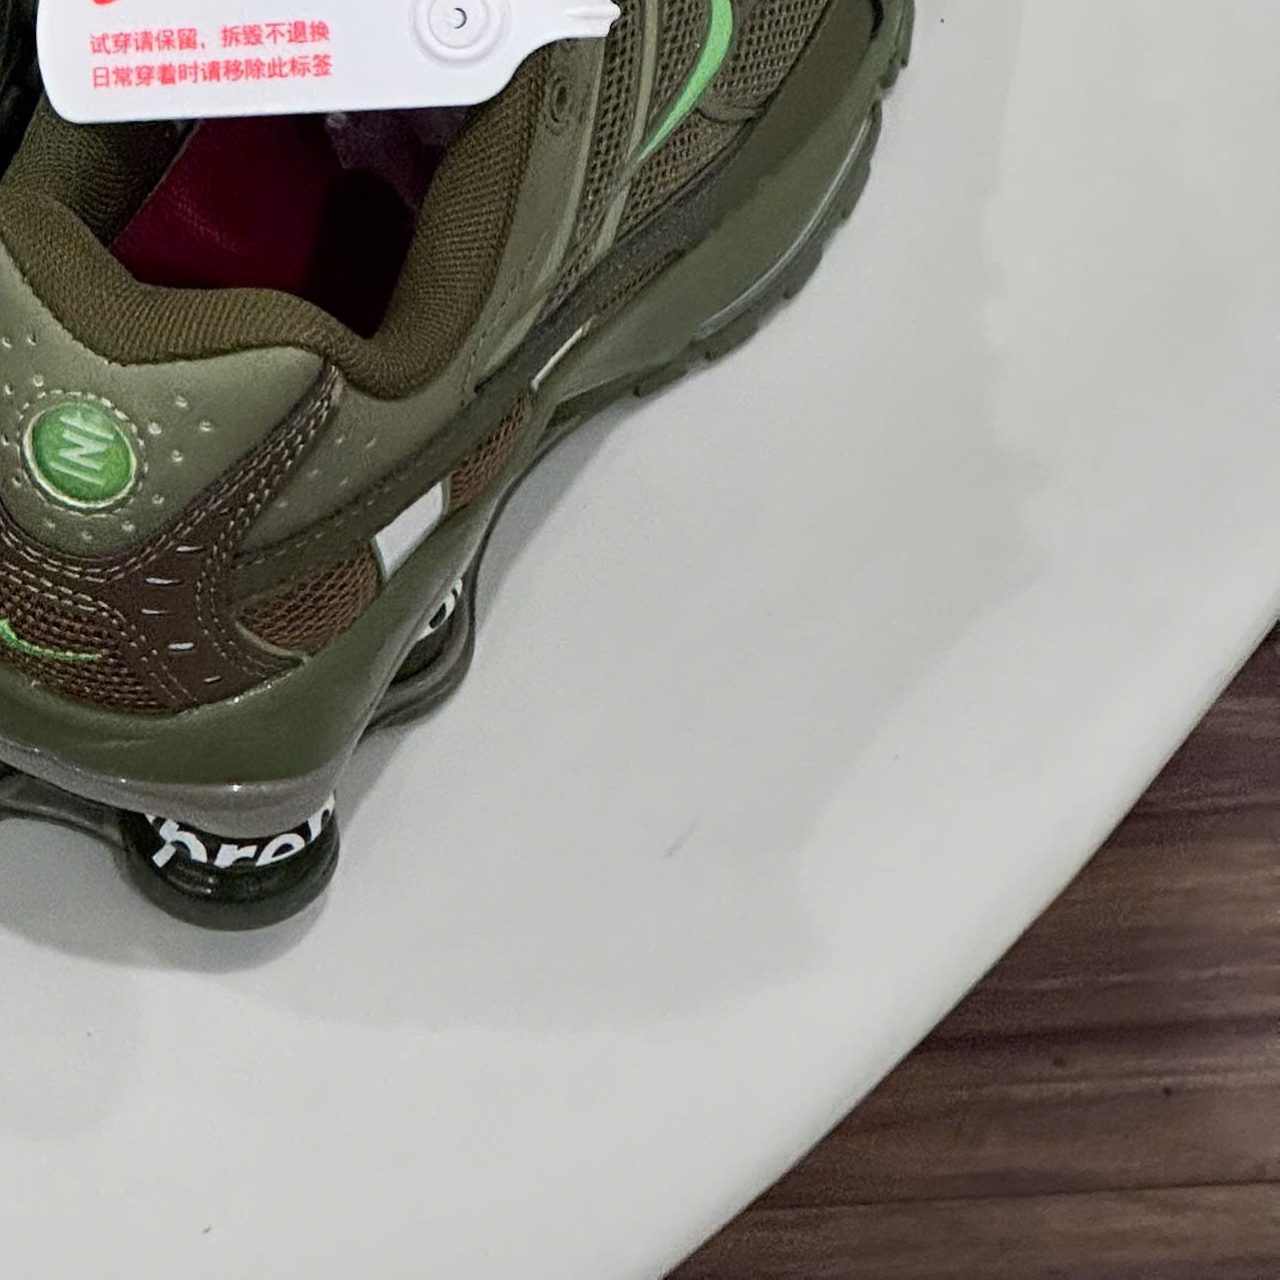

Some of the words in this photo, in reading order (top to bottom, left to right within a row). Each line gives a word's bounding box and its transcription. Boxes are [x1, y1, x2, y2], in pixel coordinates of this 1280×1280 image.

[92, 54, 333, 89] 日常穿着时请移除此标签
